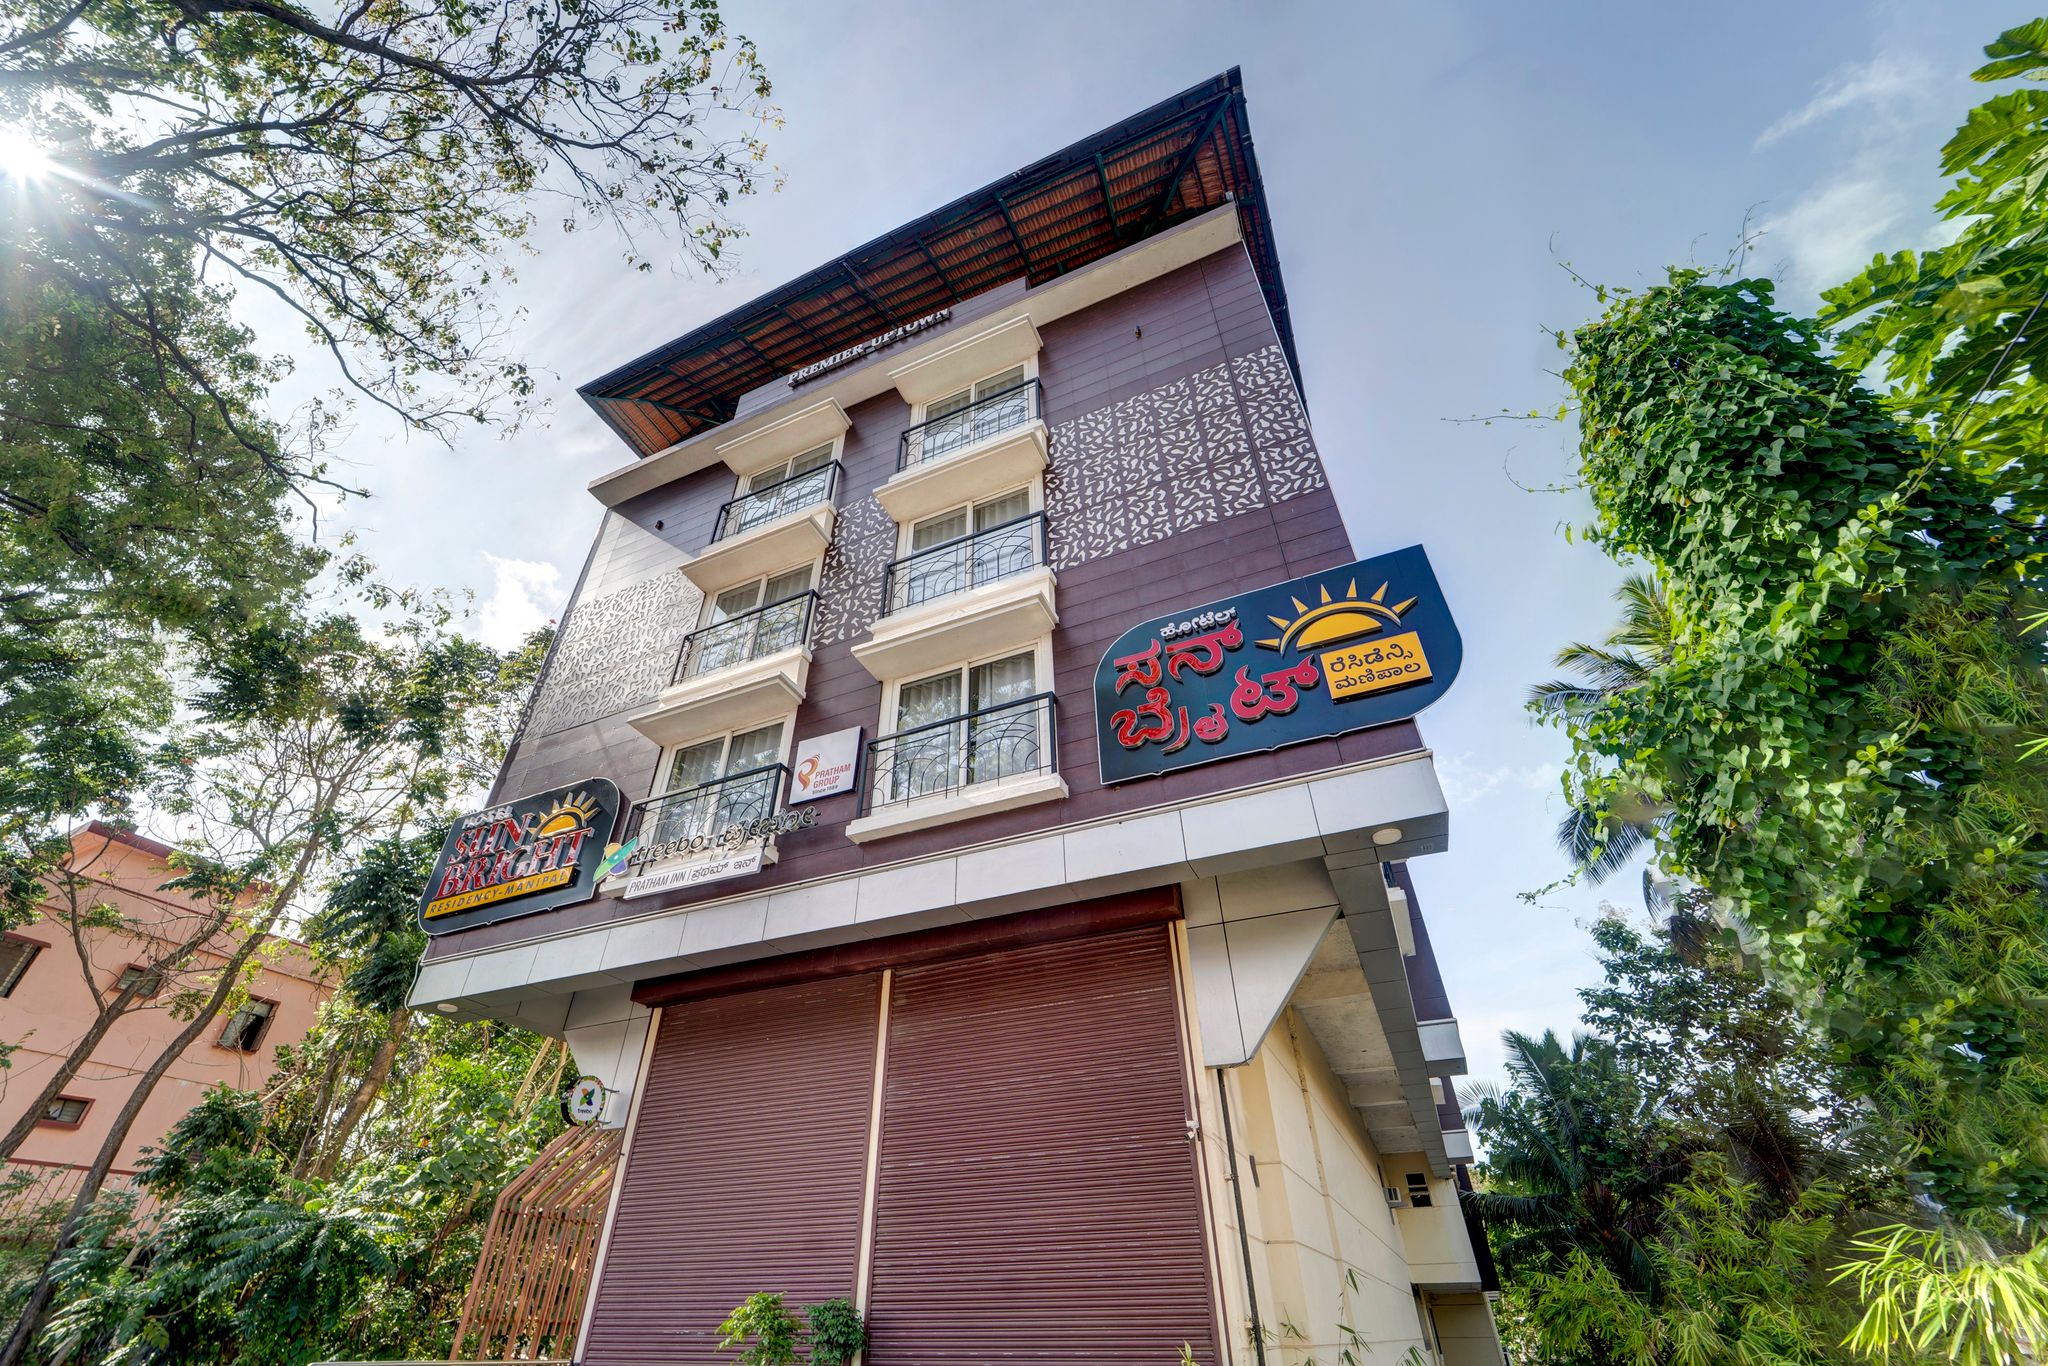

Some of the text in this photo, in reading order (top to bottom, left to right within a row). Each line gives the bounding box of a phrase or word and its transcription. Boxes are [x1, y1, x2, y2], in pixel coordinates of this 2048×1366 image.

[787, 343, 865, 388] PREMIER
[1160, 606, 1237, 639] ಹೋಟೆಲ್
[1113, 618, 1244, 696] ಸನ್
[1329, 643, 1414, 673] ರೆಸಿಡೆನ್ಸಿ
[1334, 662, 1422, 690] ಮಣಿಪಾಲ
[813, 776, 840, 789] GROUP
[814, 763, 851, 779] PRATHAM
[447, 812, 536, 865] SUN
[635, 833, 705, 864] treebo
[433, 827, 595, 900] BRIGHT
[629, 874, 669, 893] PRATHAM
[669, 870, 686, 884] INN
